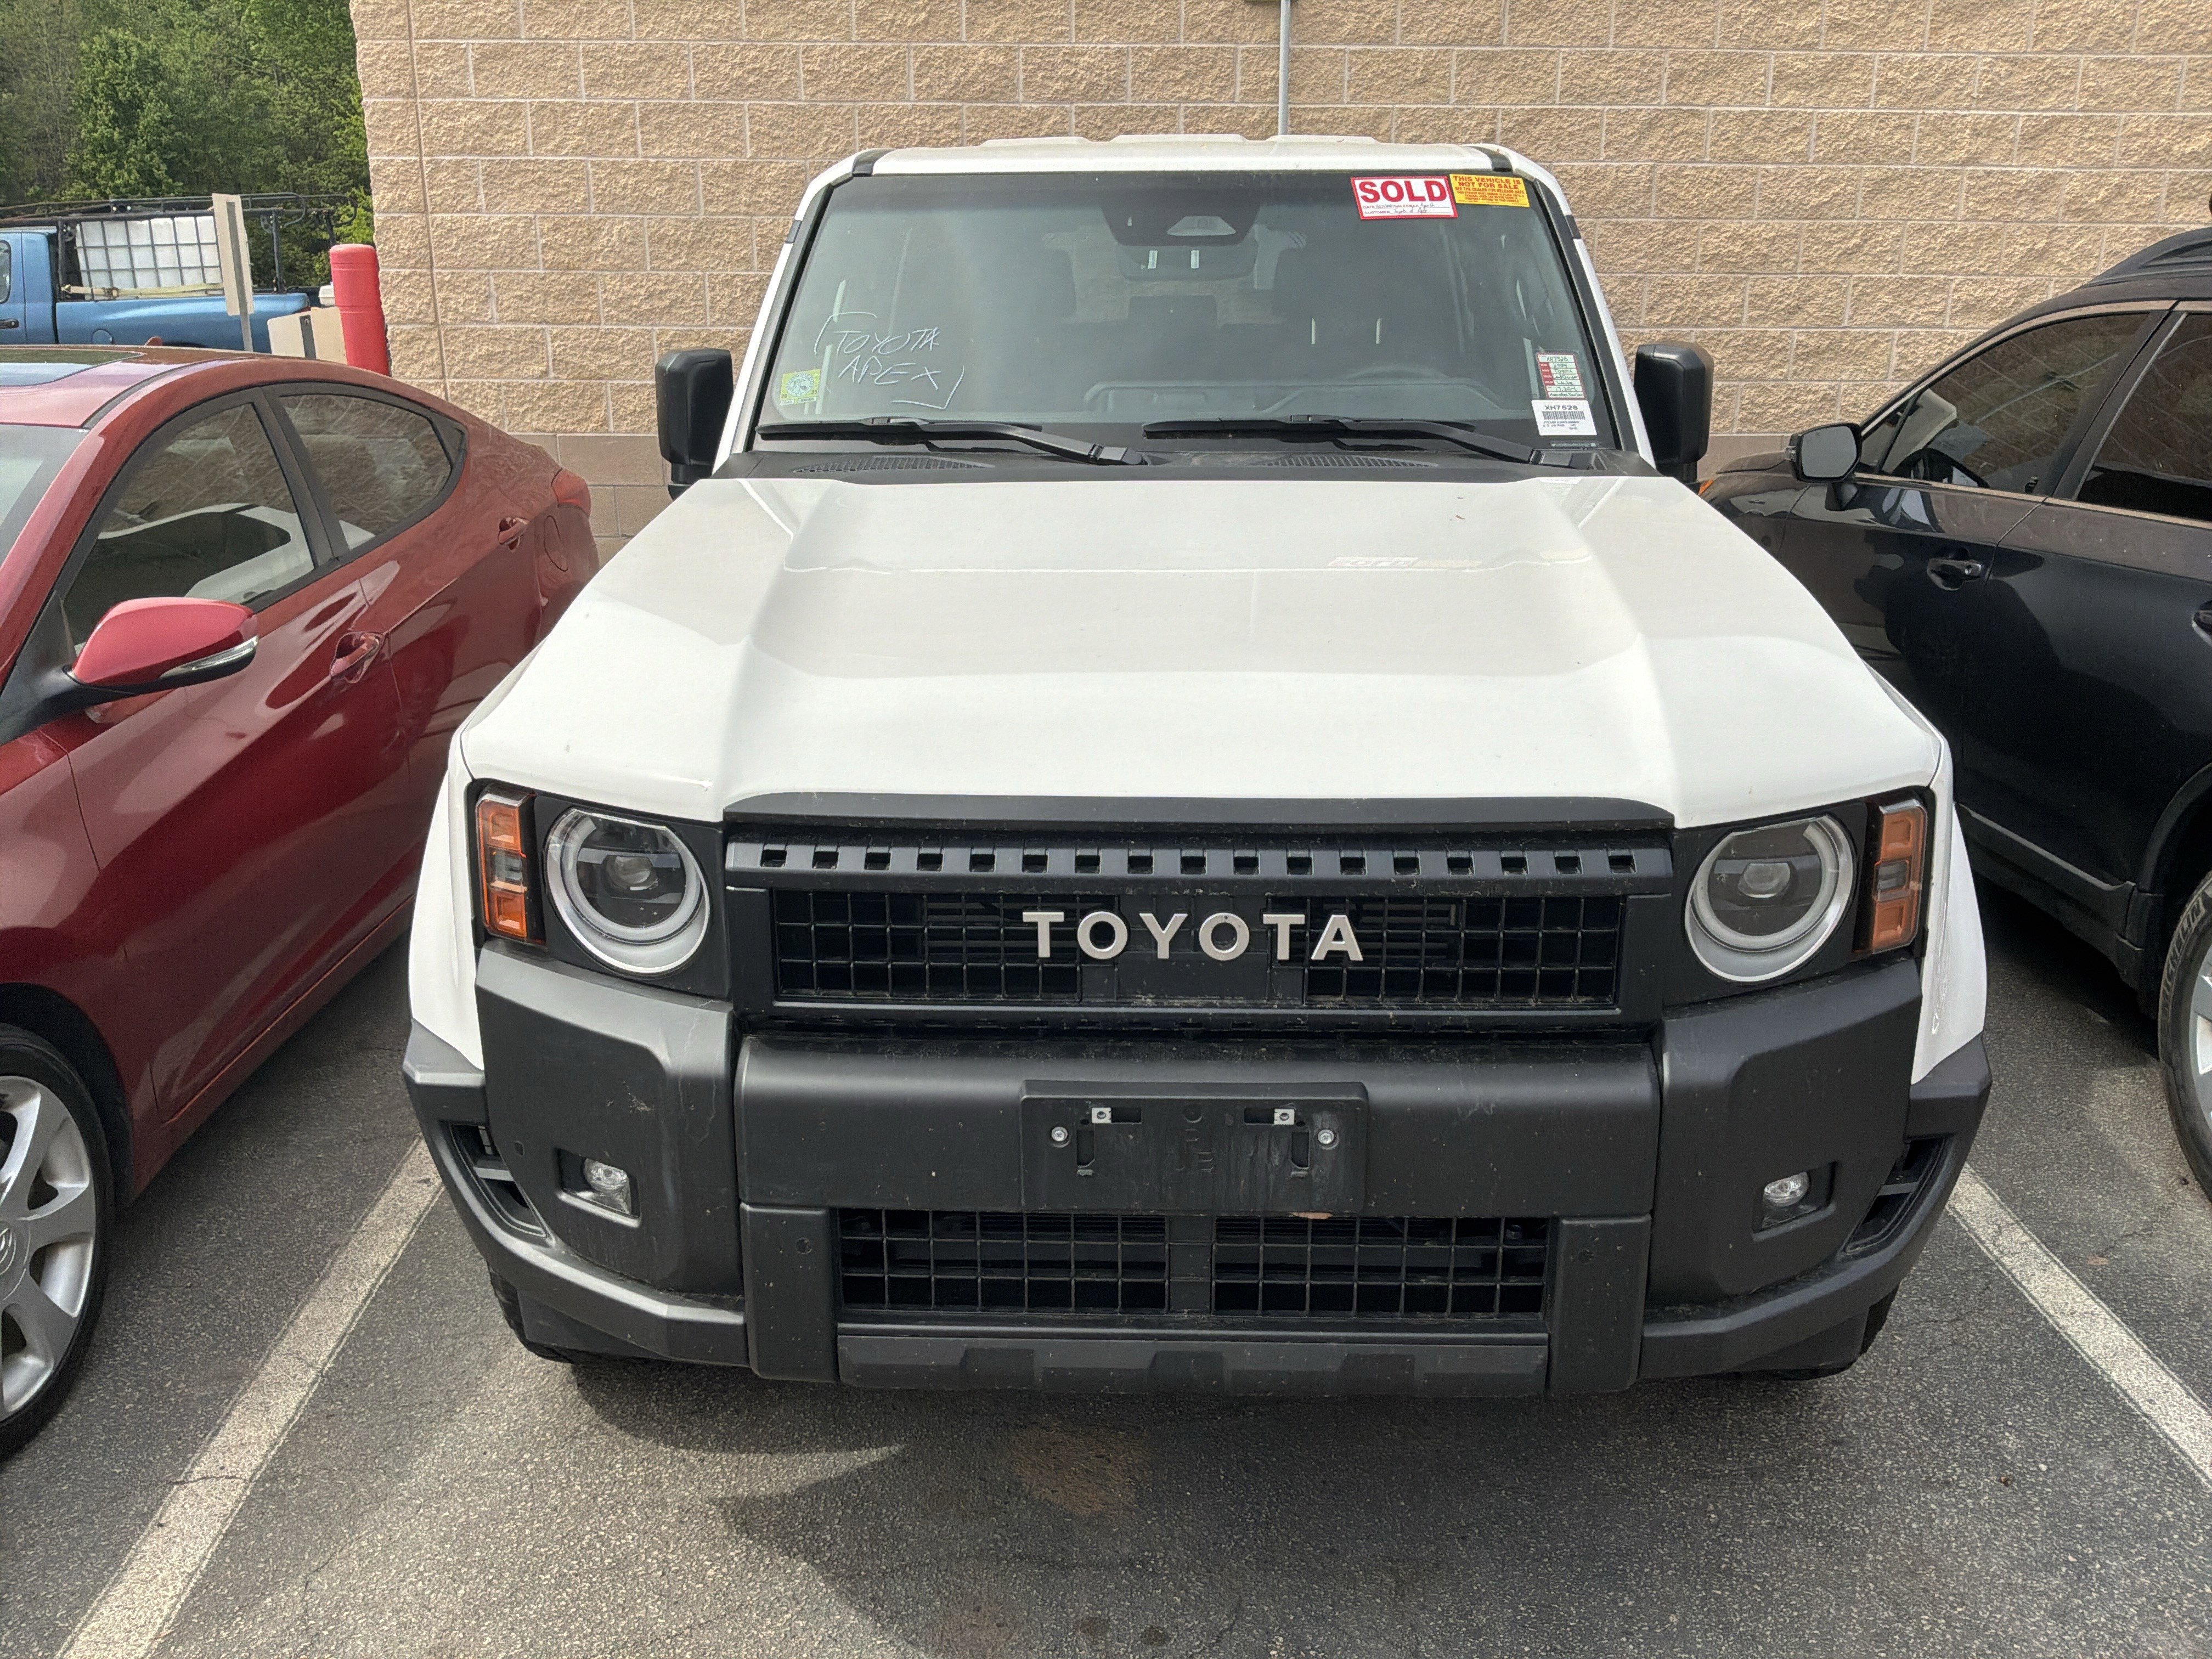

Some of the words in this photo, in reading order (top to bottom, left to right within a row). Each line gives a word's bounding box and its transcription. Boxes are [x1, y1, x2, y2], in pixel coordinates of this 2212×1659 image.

[1359, 180, 1447, 203] SOLD
[833, 327, 940, 355] TOYOTA
[838, 354, 942, 391] APEX
[1022, 911, 1364, 961] TOYOTA
